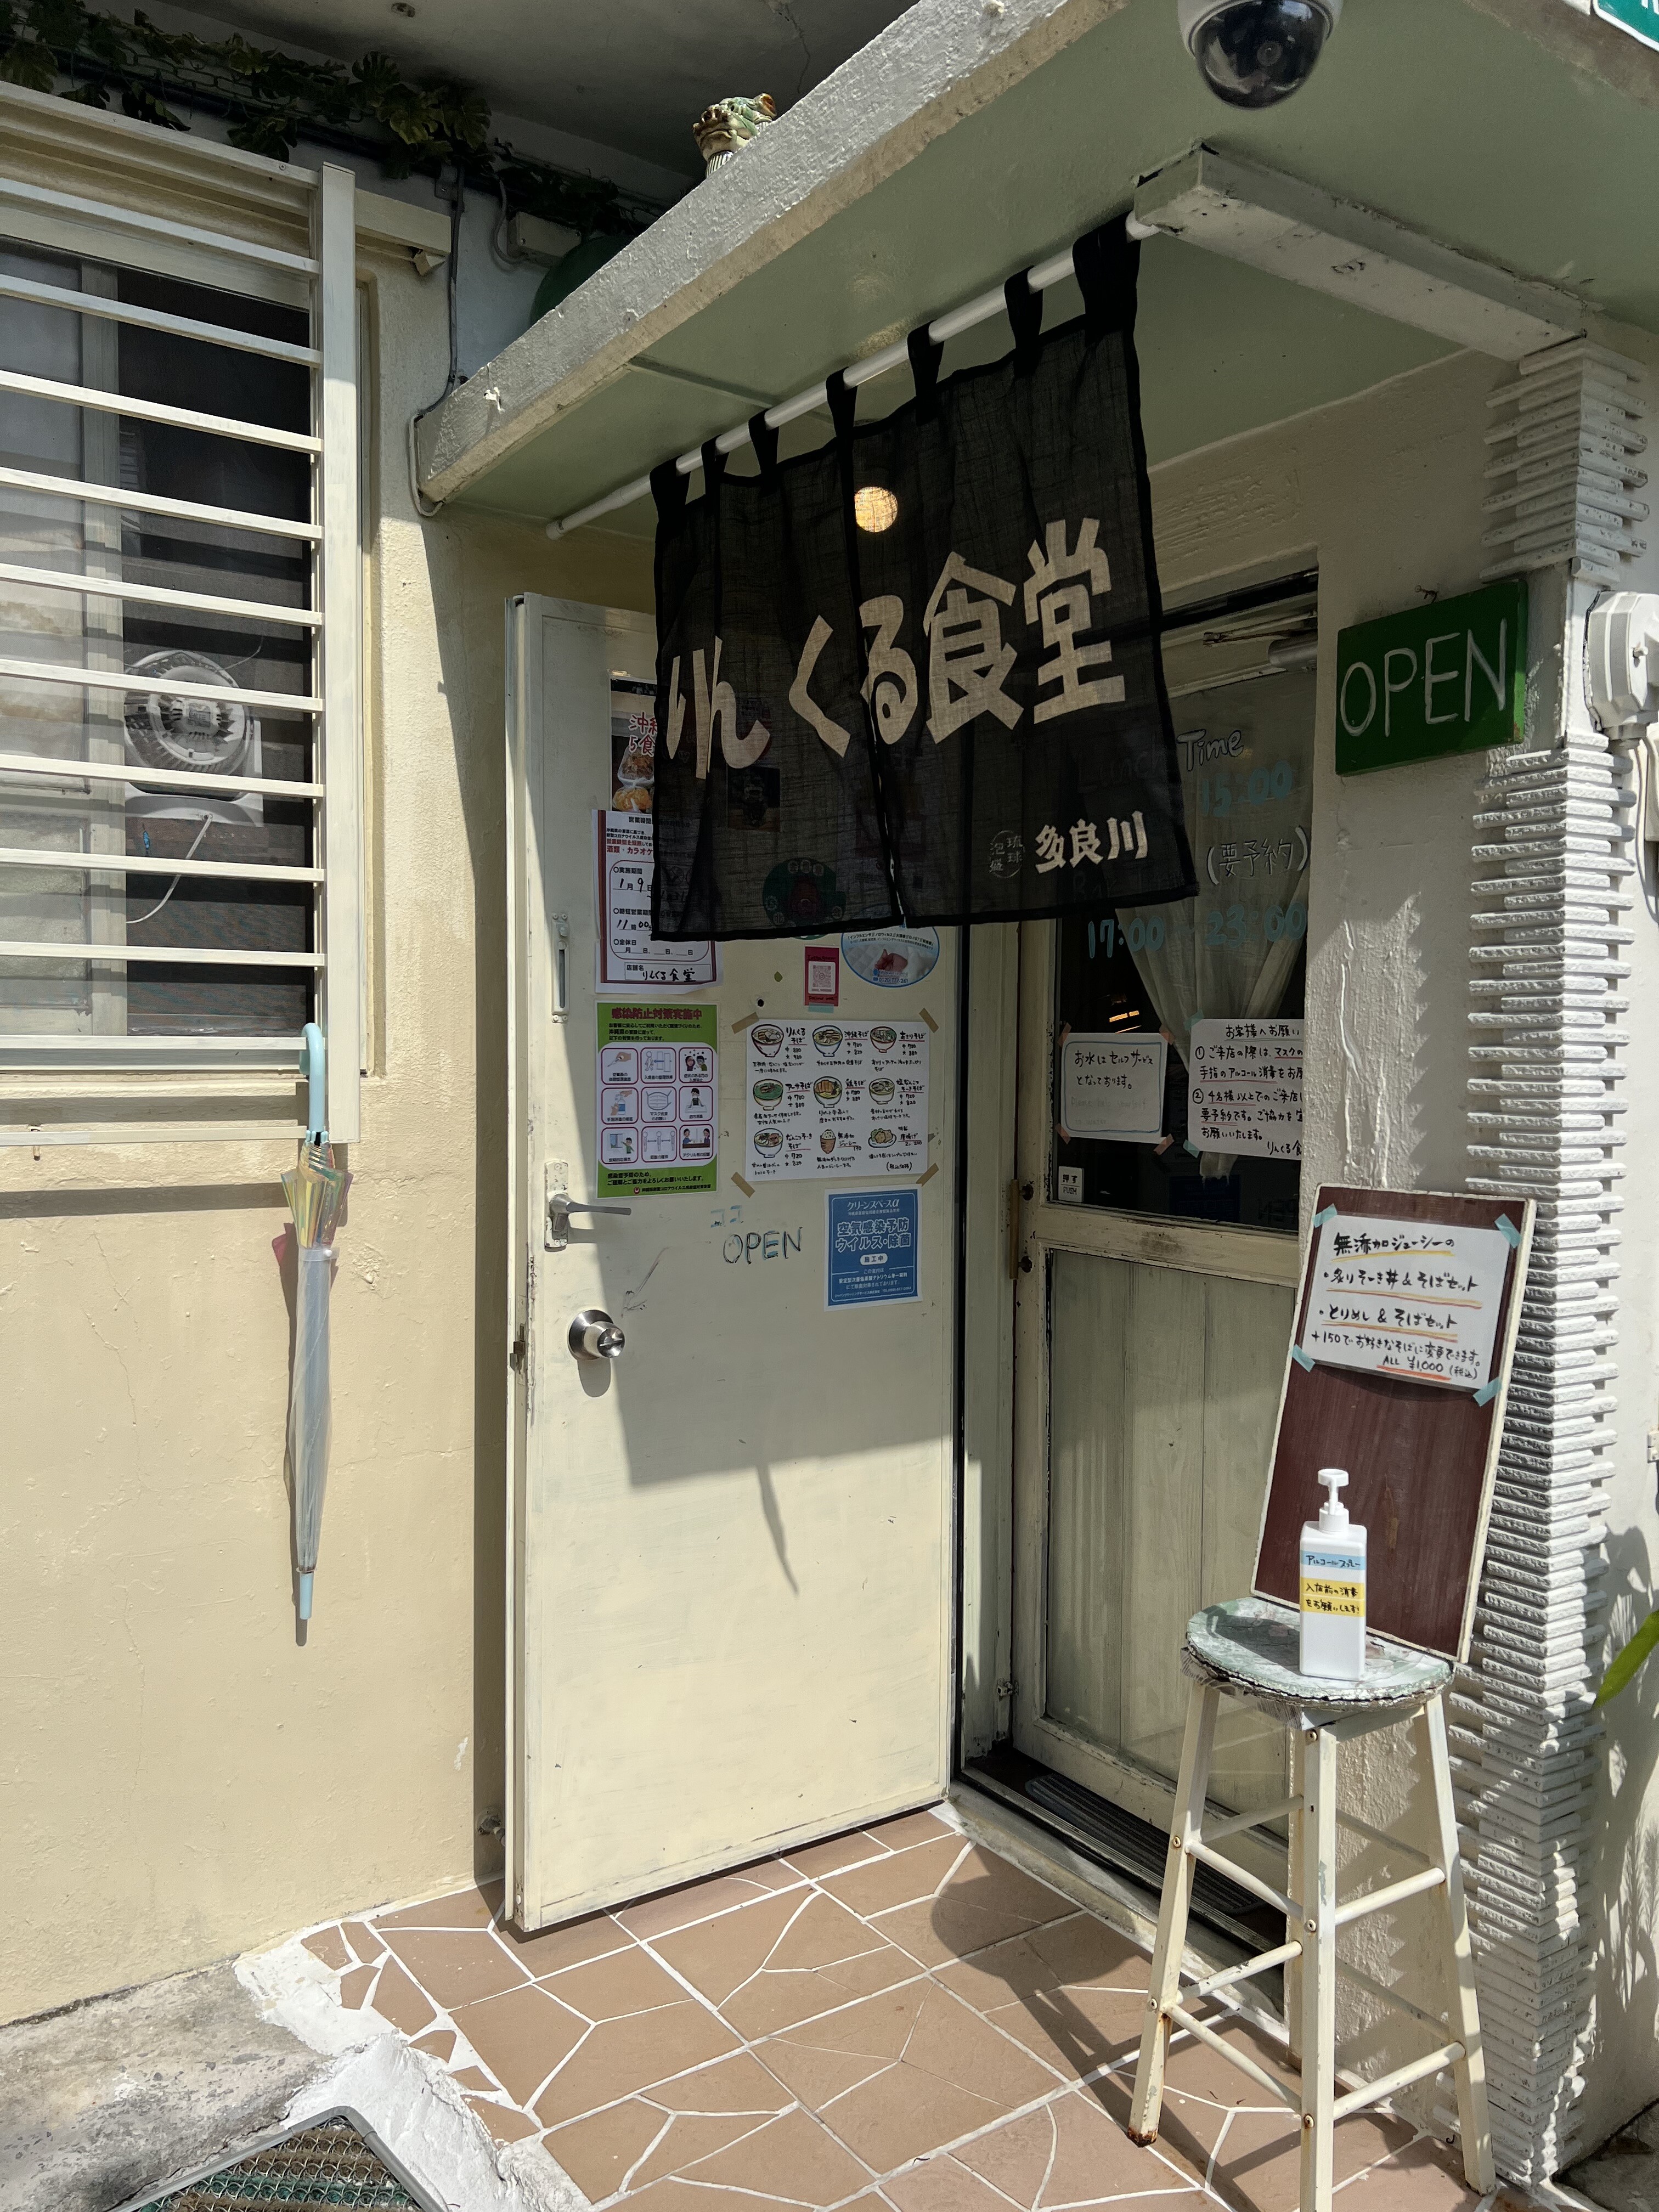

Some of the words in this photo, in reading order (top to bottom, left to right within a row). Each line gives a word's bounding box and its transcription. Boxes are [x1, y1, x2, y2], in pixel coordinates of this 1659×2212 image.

[666, 517, 1127, 782] りんくる食堂
[1340, 618, 1507, 737] OPEN
[1176, 729, 1244, 771] Time
[1035, 810, 1148, 874] 多良川
[1206, 826, 1309, 885] (要予約)
[1087, 916, 1164, 959] 17:00
[1206, 901, 1306, 948] 23:00
[612, 1007, 702, 1020] 感染防止対策実施中
[786, 1027, 806, 1037] りんくる
[900, 1030, 926, 1040] あさりそば
[1226, 1024, 1299, 1040] お客様へお願い
[1074, 1049, 1153, 1068] お水はセルフサービス
[785, 1082, 813, 1091] アーサそば
[1076, 1074, 1132, 1089] となっております。
[1201, 1127, 1262, 1141] お願いいたします。
[1063, 1174, 1078, 1184] 押す
[1063, 1186, 1077, 1195] PUSH
[837, 1217, 909, 1237] 空気感染予防
[723, 1227, 803, 1264] OPEN
[835, 1233, 911, 1253] ウイルス・除菌
[1333, 1232, 1454, 1256] 無添加ジューシーの
[1402, 1272, 1412, 1285] &
[1418, 1271, 1479, 1292] そばセット
[1377, 1308, 1387, 1323] &
[1394, 1308, 1458, 1329] そばセット
[1383, 1354, 1400, 1366] ALL
[1449, 1367, 1479, 1380] (税込)
[1306, 1583, 1358, 1599] 入店前の消毒
